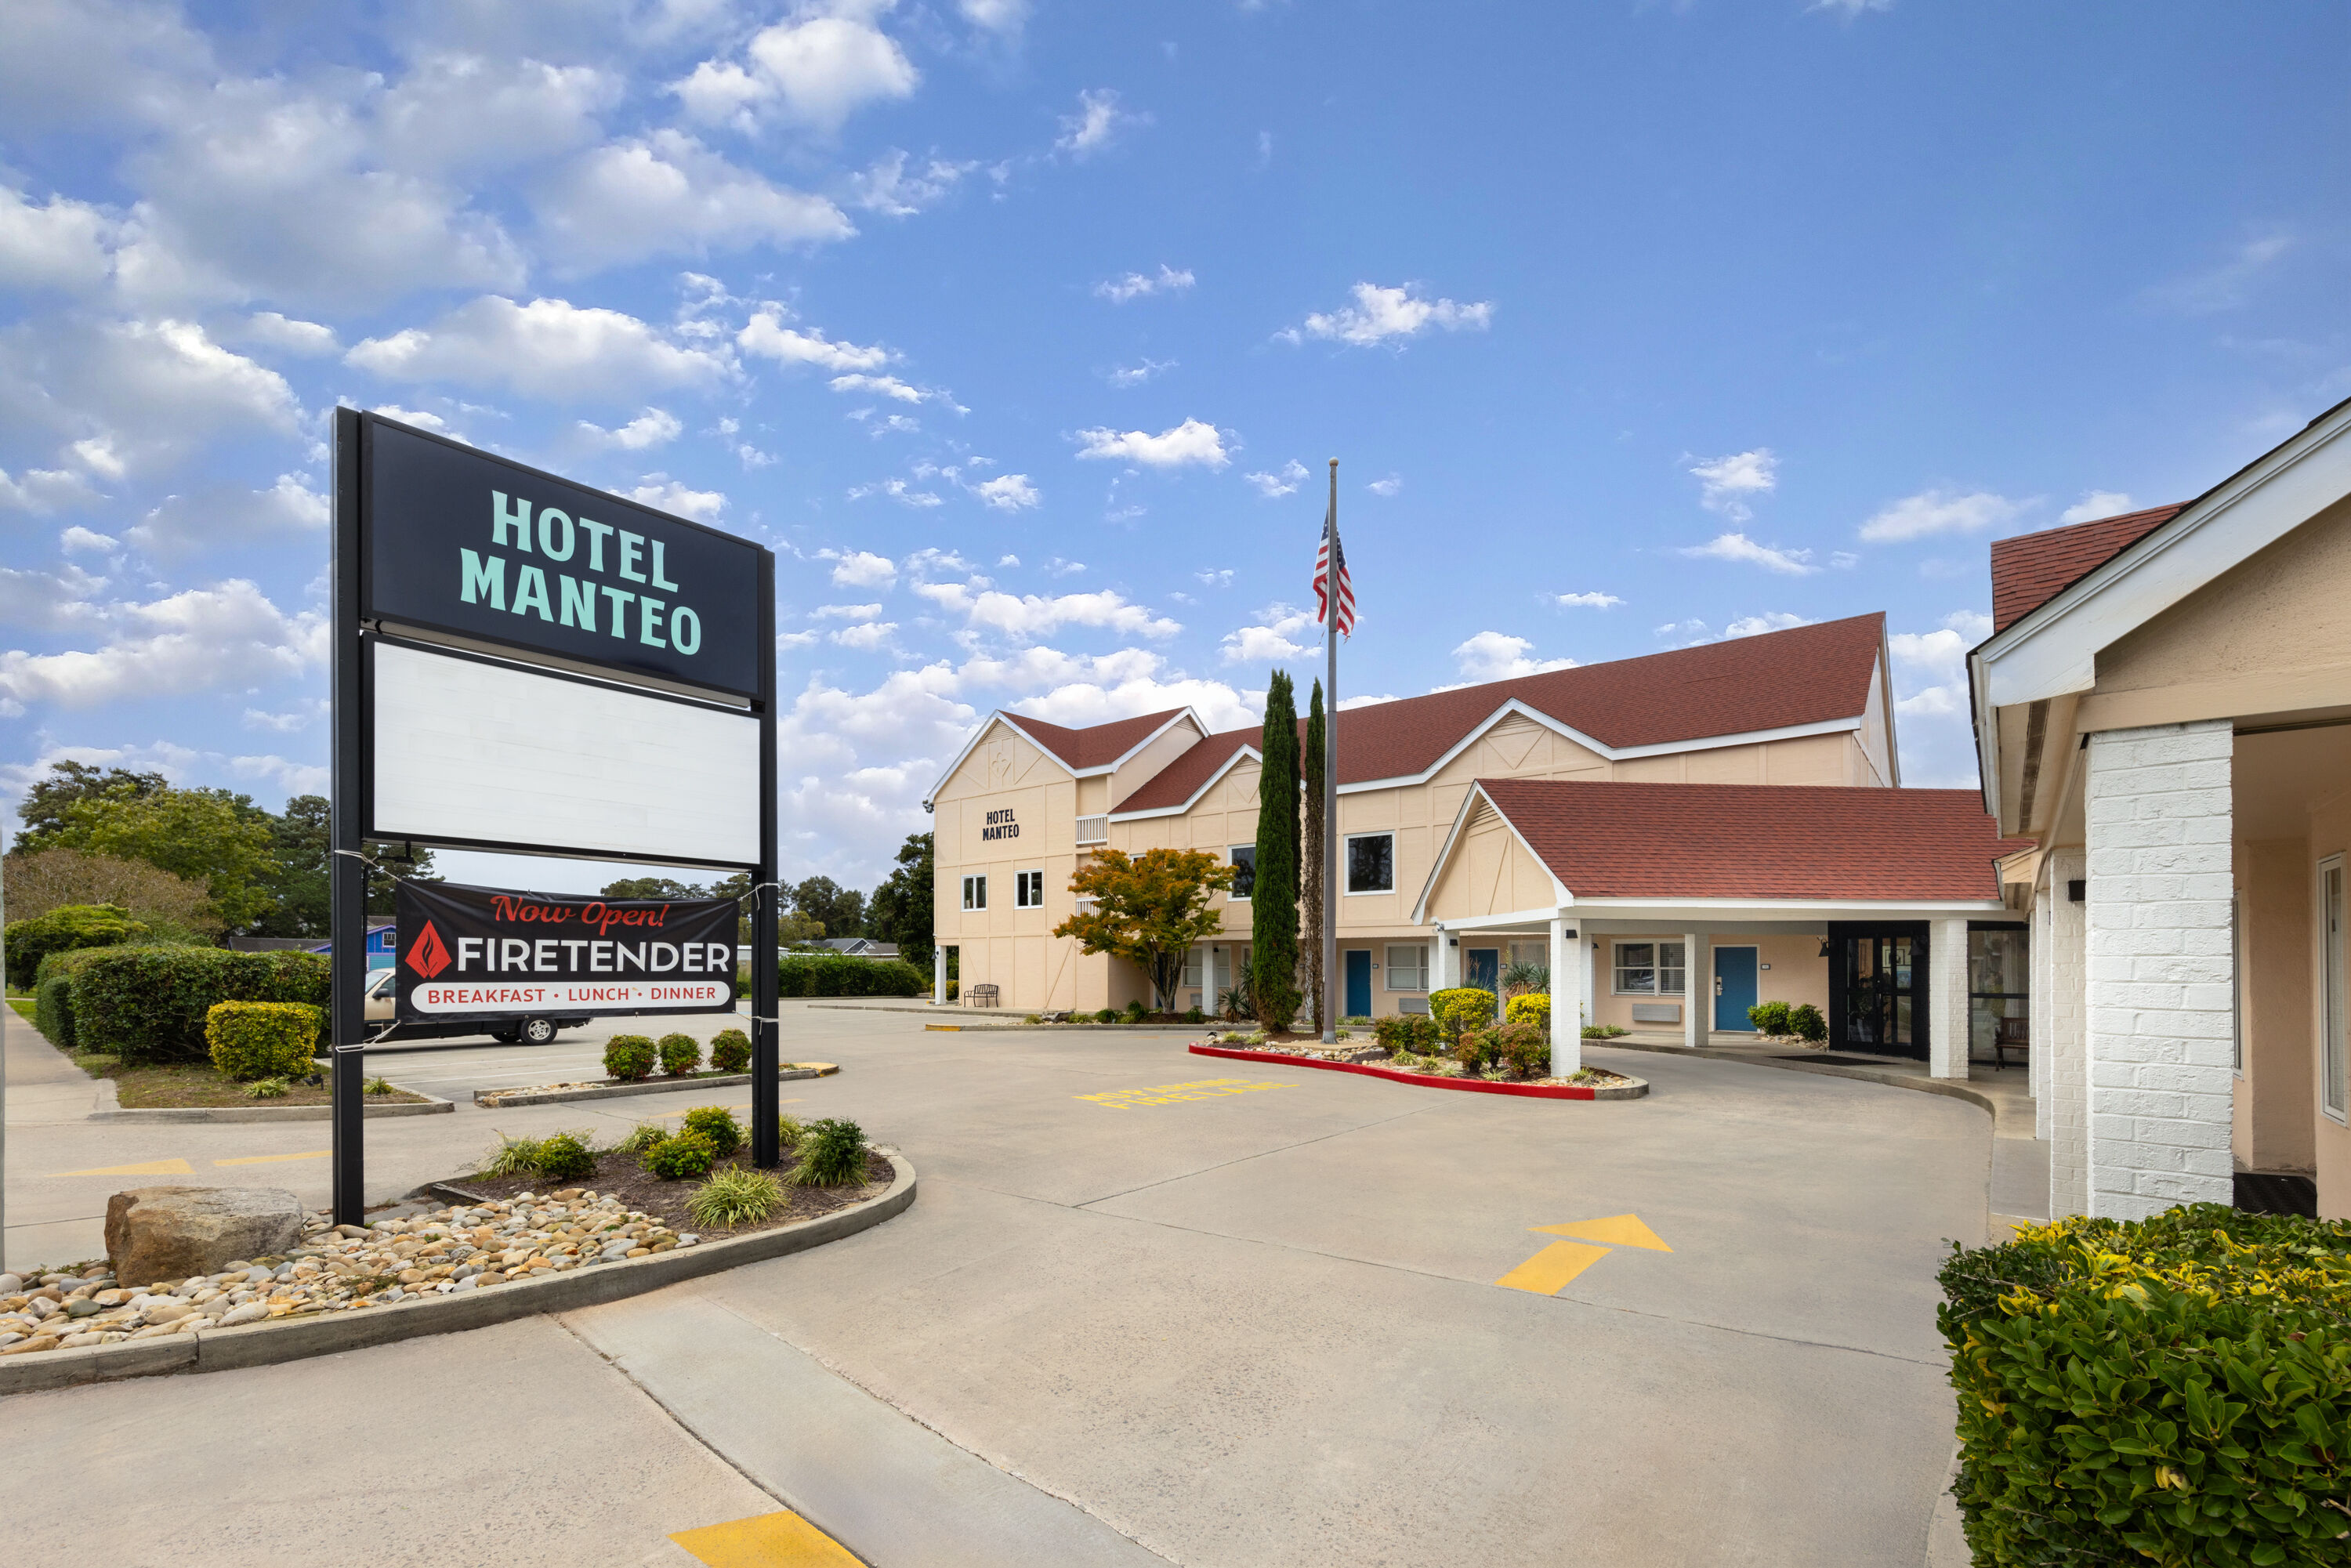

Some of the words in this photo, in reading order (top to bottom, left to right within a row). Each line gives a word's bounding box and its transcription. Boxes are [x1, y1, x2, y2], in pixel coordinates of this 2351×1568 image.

[491, 490, 679, 593] HOTEL
[460, 547, 701, 656] MANTEO
[986, 808, 1016, 825] HOTEL
[982, 824, 1020, 842] MANTEO
[490, 895, 576, 923] Now
[581, 901, 670, 936] Open!
[458, 936, 730, 972] FIRETENDER
[427, 988, 546, 1005] BREAKFAST
[567, 987, 629, 1001] LUNCH
[650, 987, 716, 1000] DINNER
[1097, 1092, 1208, 1110] FIRE
[1190, 1081, 1300, 1097] LANE
